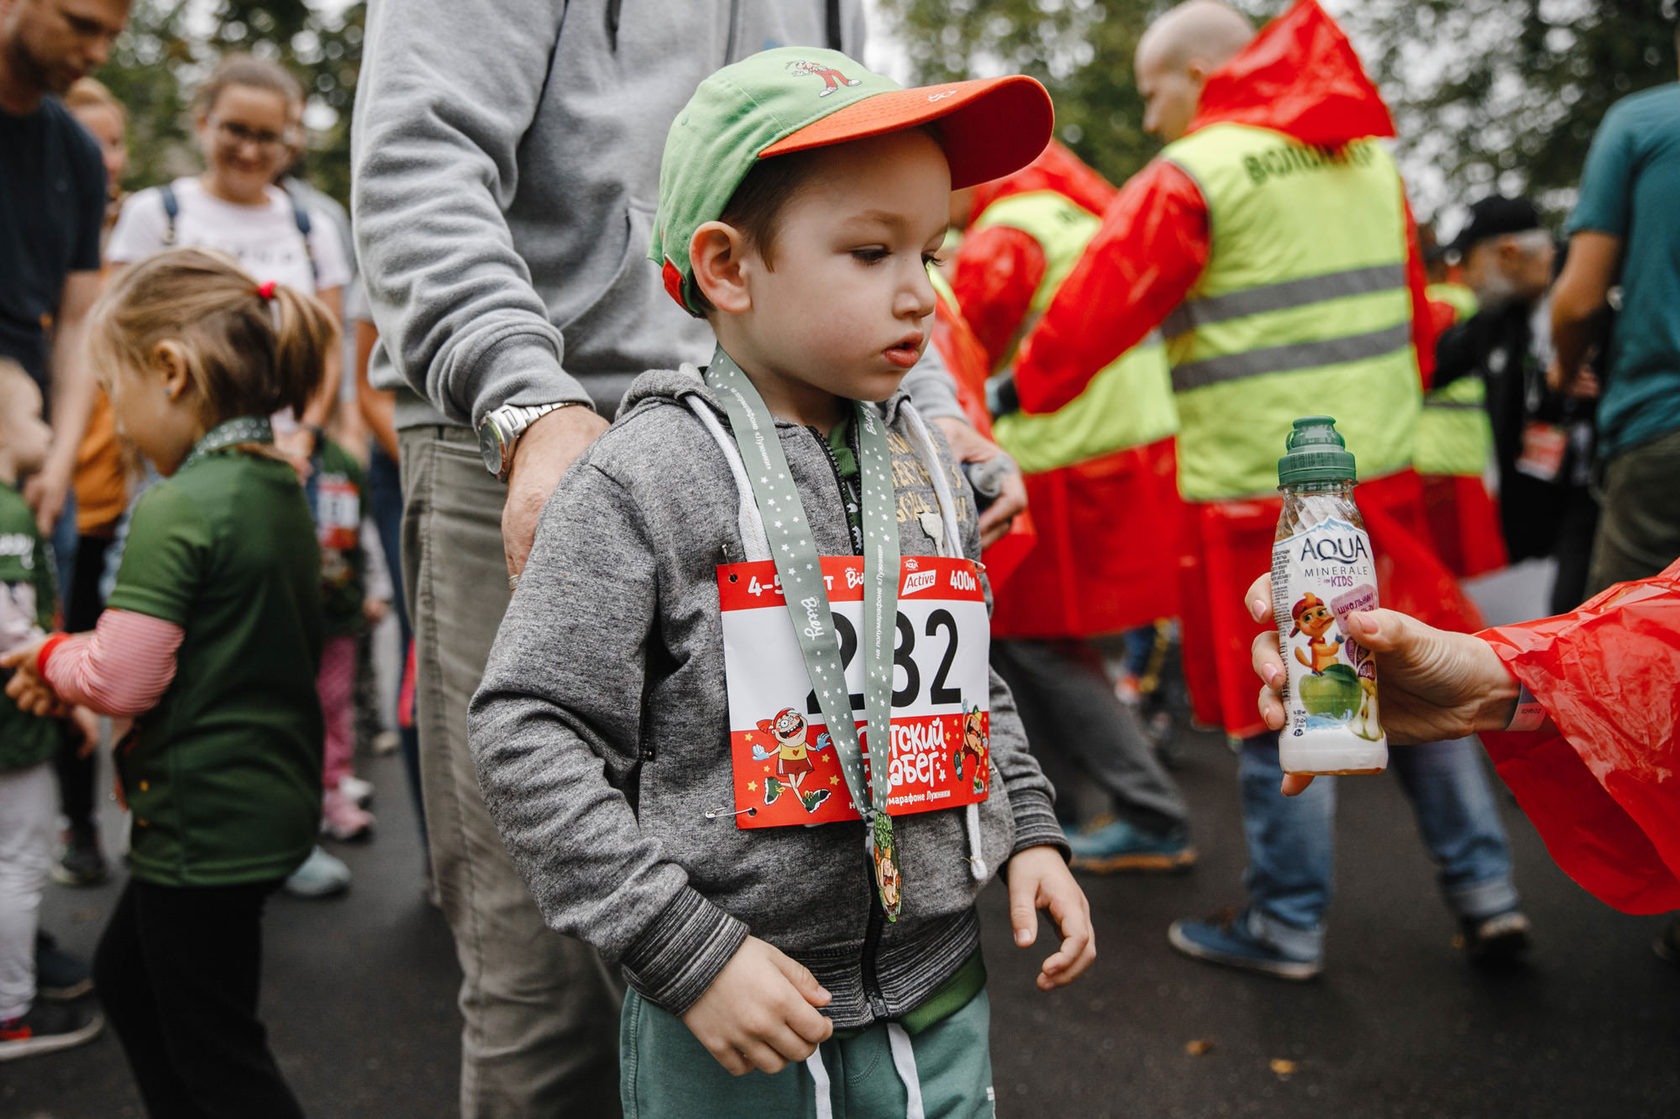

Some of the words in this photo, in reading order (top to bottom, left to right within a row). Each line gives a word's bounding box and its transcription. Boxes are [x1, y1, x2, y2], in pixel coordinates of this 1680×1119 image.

[1300, 535, 1368, 564] AQUA
[1304, 566, 1368, 577] MINERALE
[906, 572, 935, 589] Active
[1331, 575, 1354, 587] KIDS
[801, 596, 825, 640] Bitey
[886, 751, 939, 794] абег
[885, 792, 925, 807] марафоне
